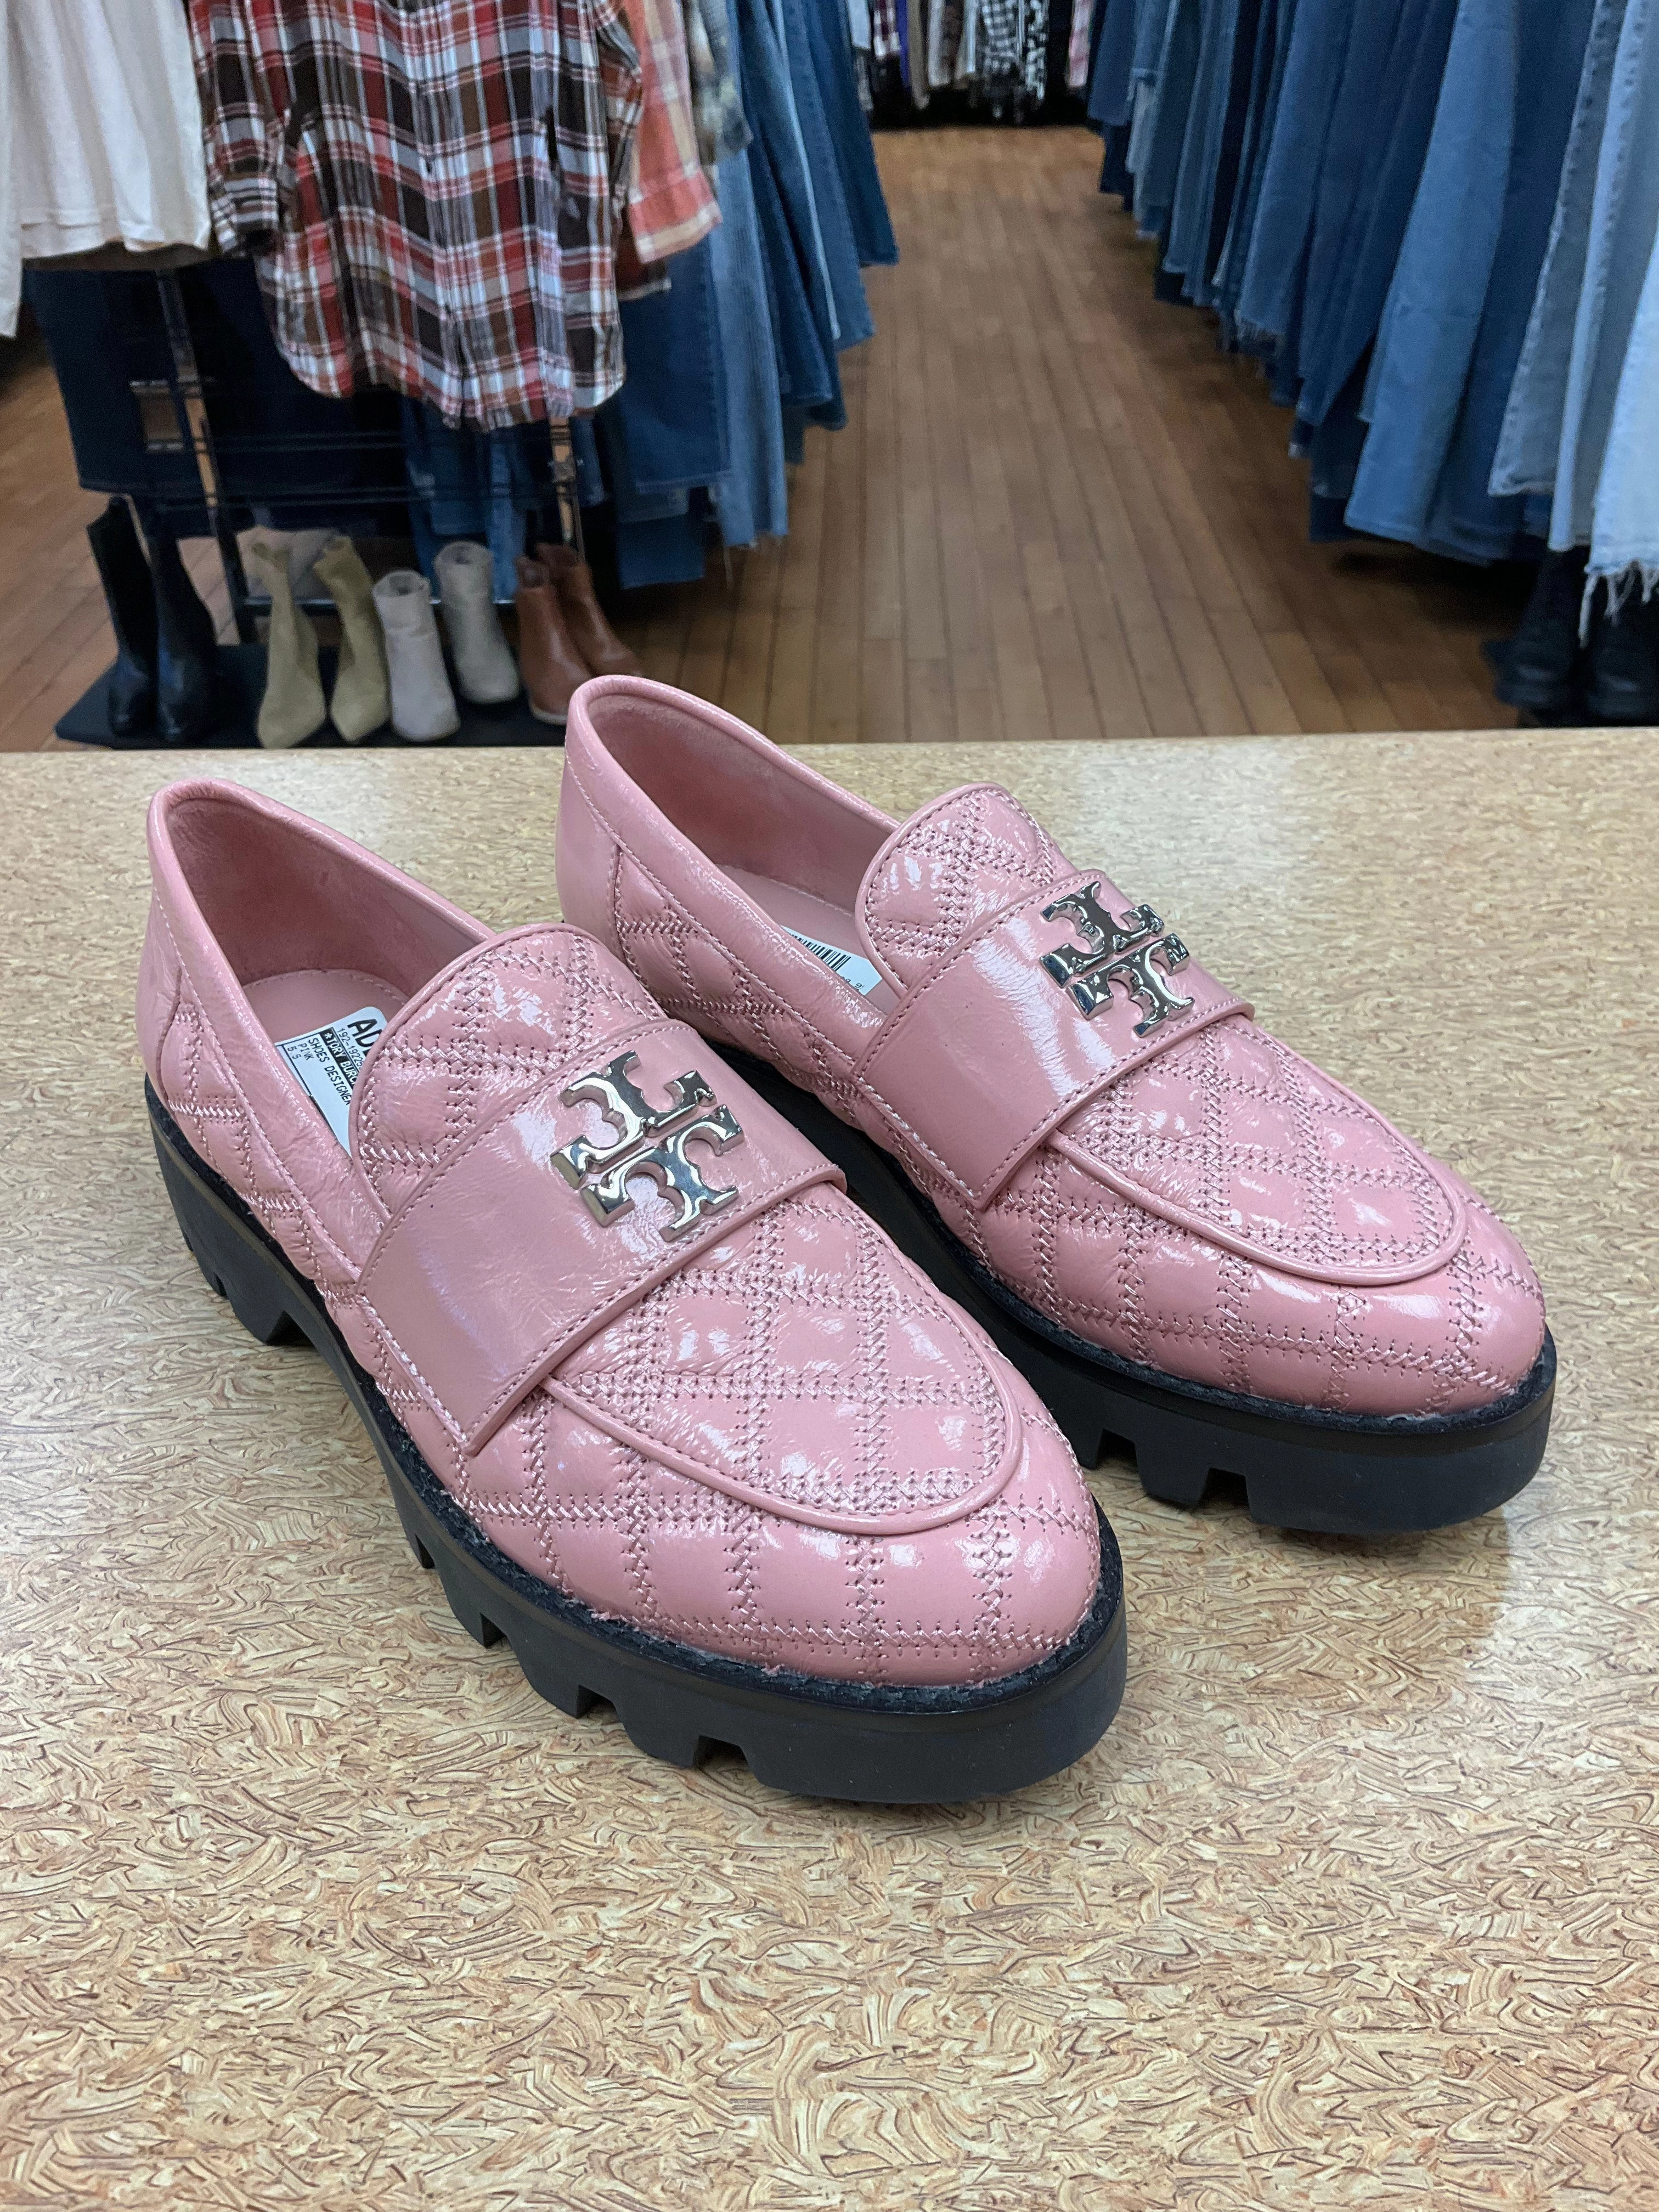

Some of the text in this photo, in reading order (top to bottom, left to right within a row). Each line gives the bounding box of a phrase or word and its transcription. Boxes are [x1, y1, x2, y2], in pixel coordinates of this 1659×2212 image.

[298, 1042, 314, 1061] PINK
[308, 1038, 330, 1063] SHOES
[337, 1028, 363, 1069] 192-19225
[347, 1018, 382, 1057] AD
